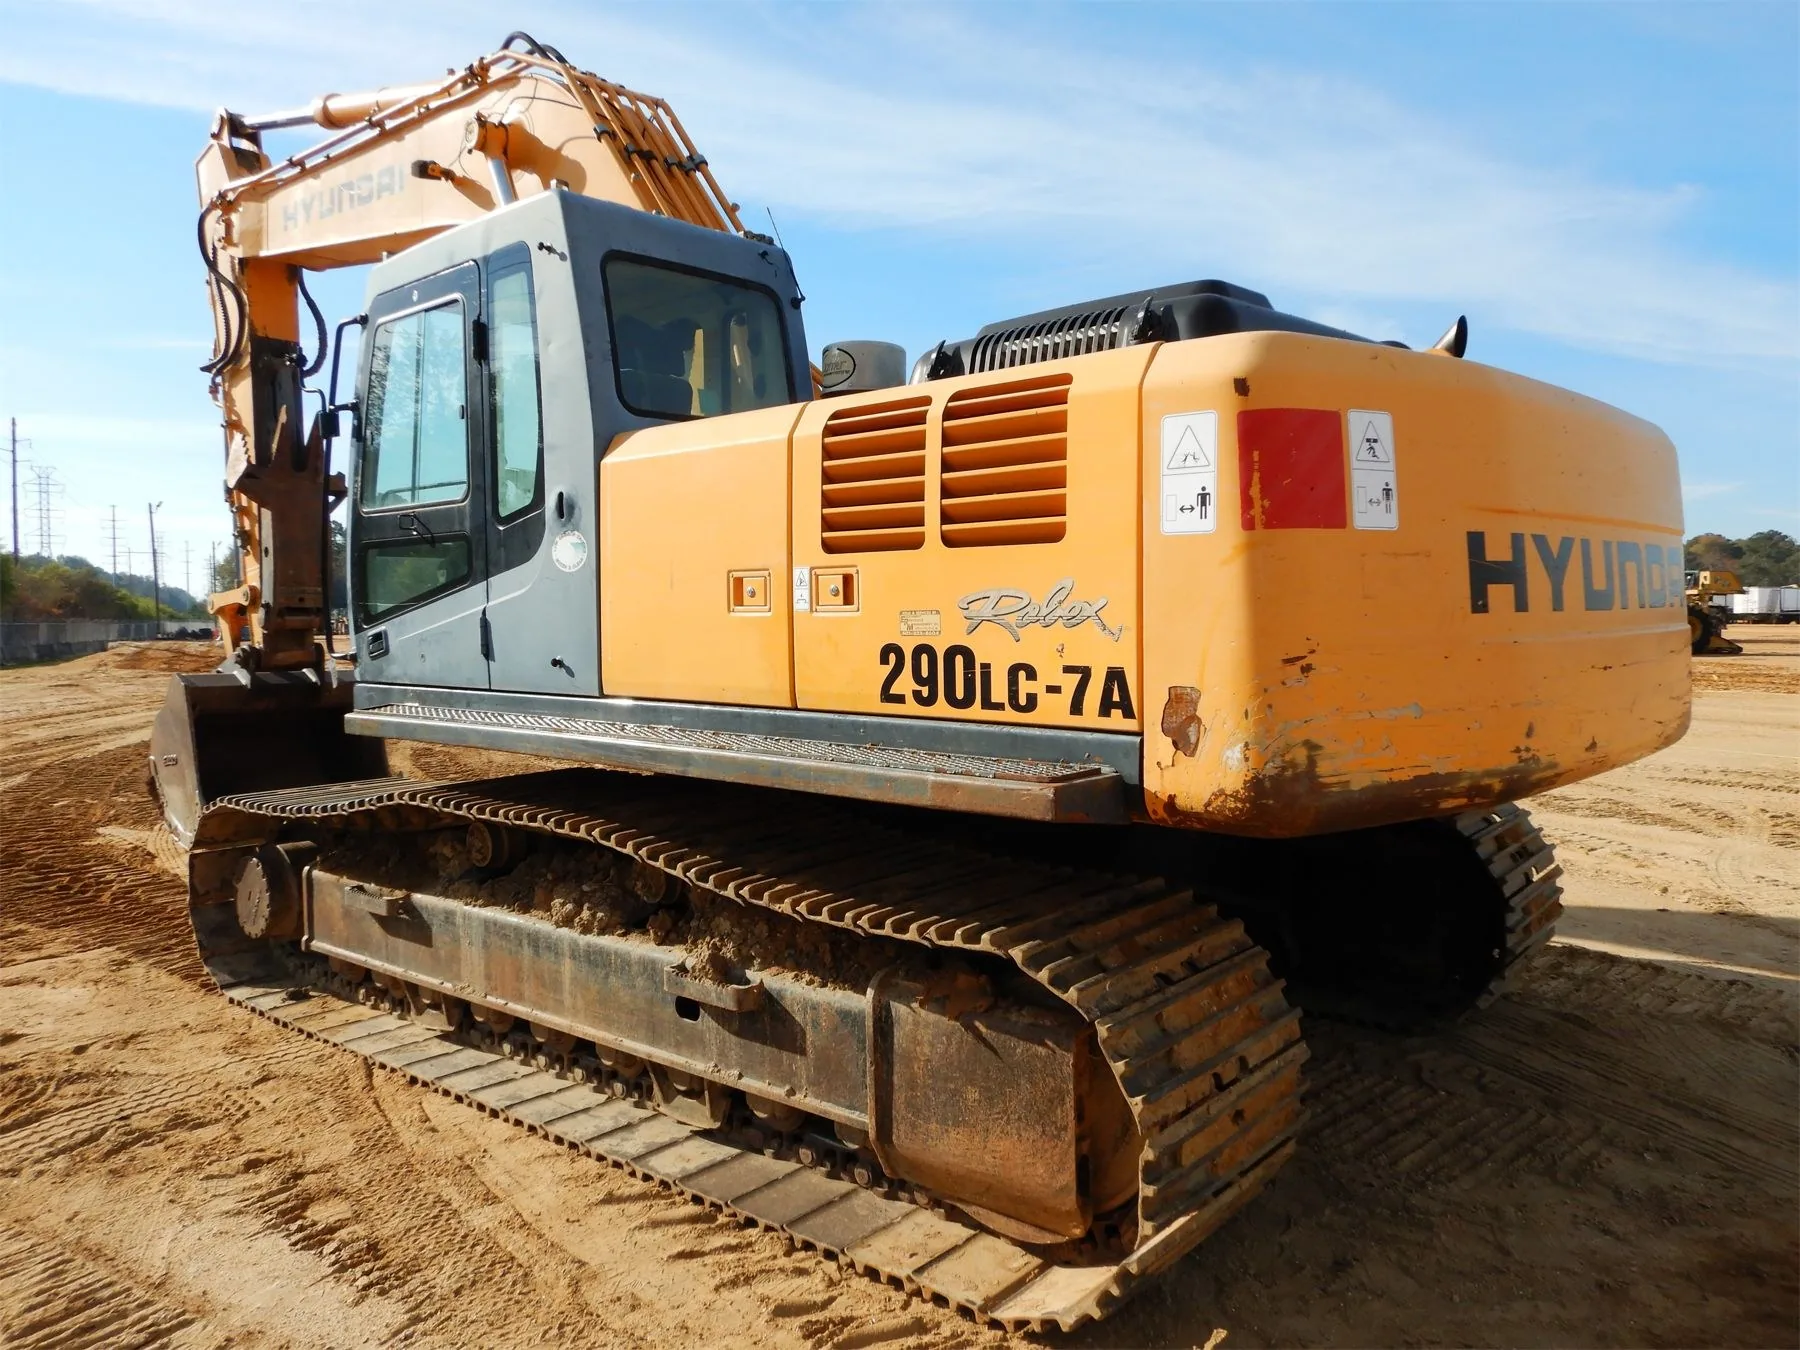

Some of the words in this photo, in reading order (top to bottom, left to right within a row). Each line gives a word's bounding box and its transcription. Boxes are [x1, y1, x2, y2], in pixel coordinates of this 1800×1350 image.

[282, 163, 405, 232] HYUNDAI
[1466, 531, 1684, 614] HYUNDA
[957, 577, 1123, 642] Robex
[879, 642, 1137, 720] 290LC-7A
